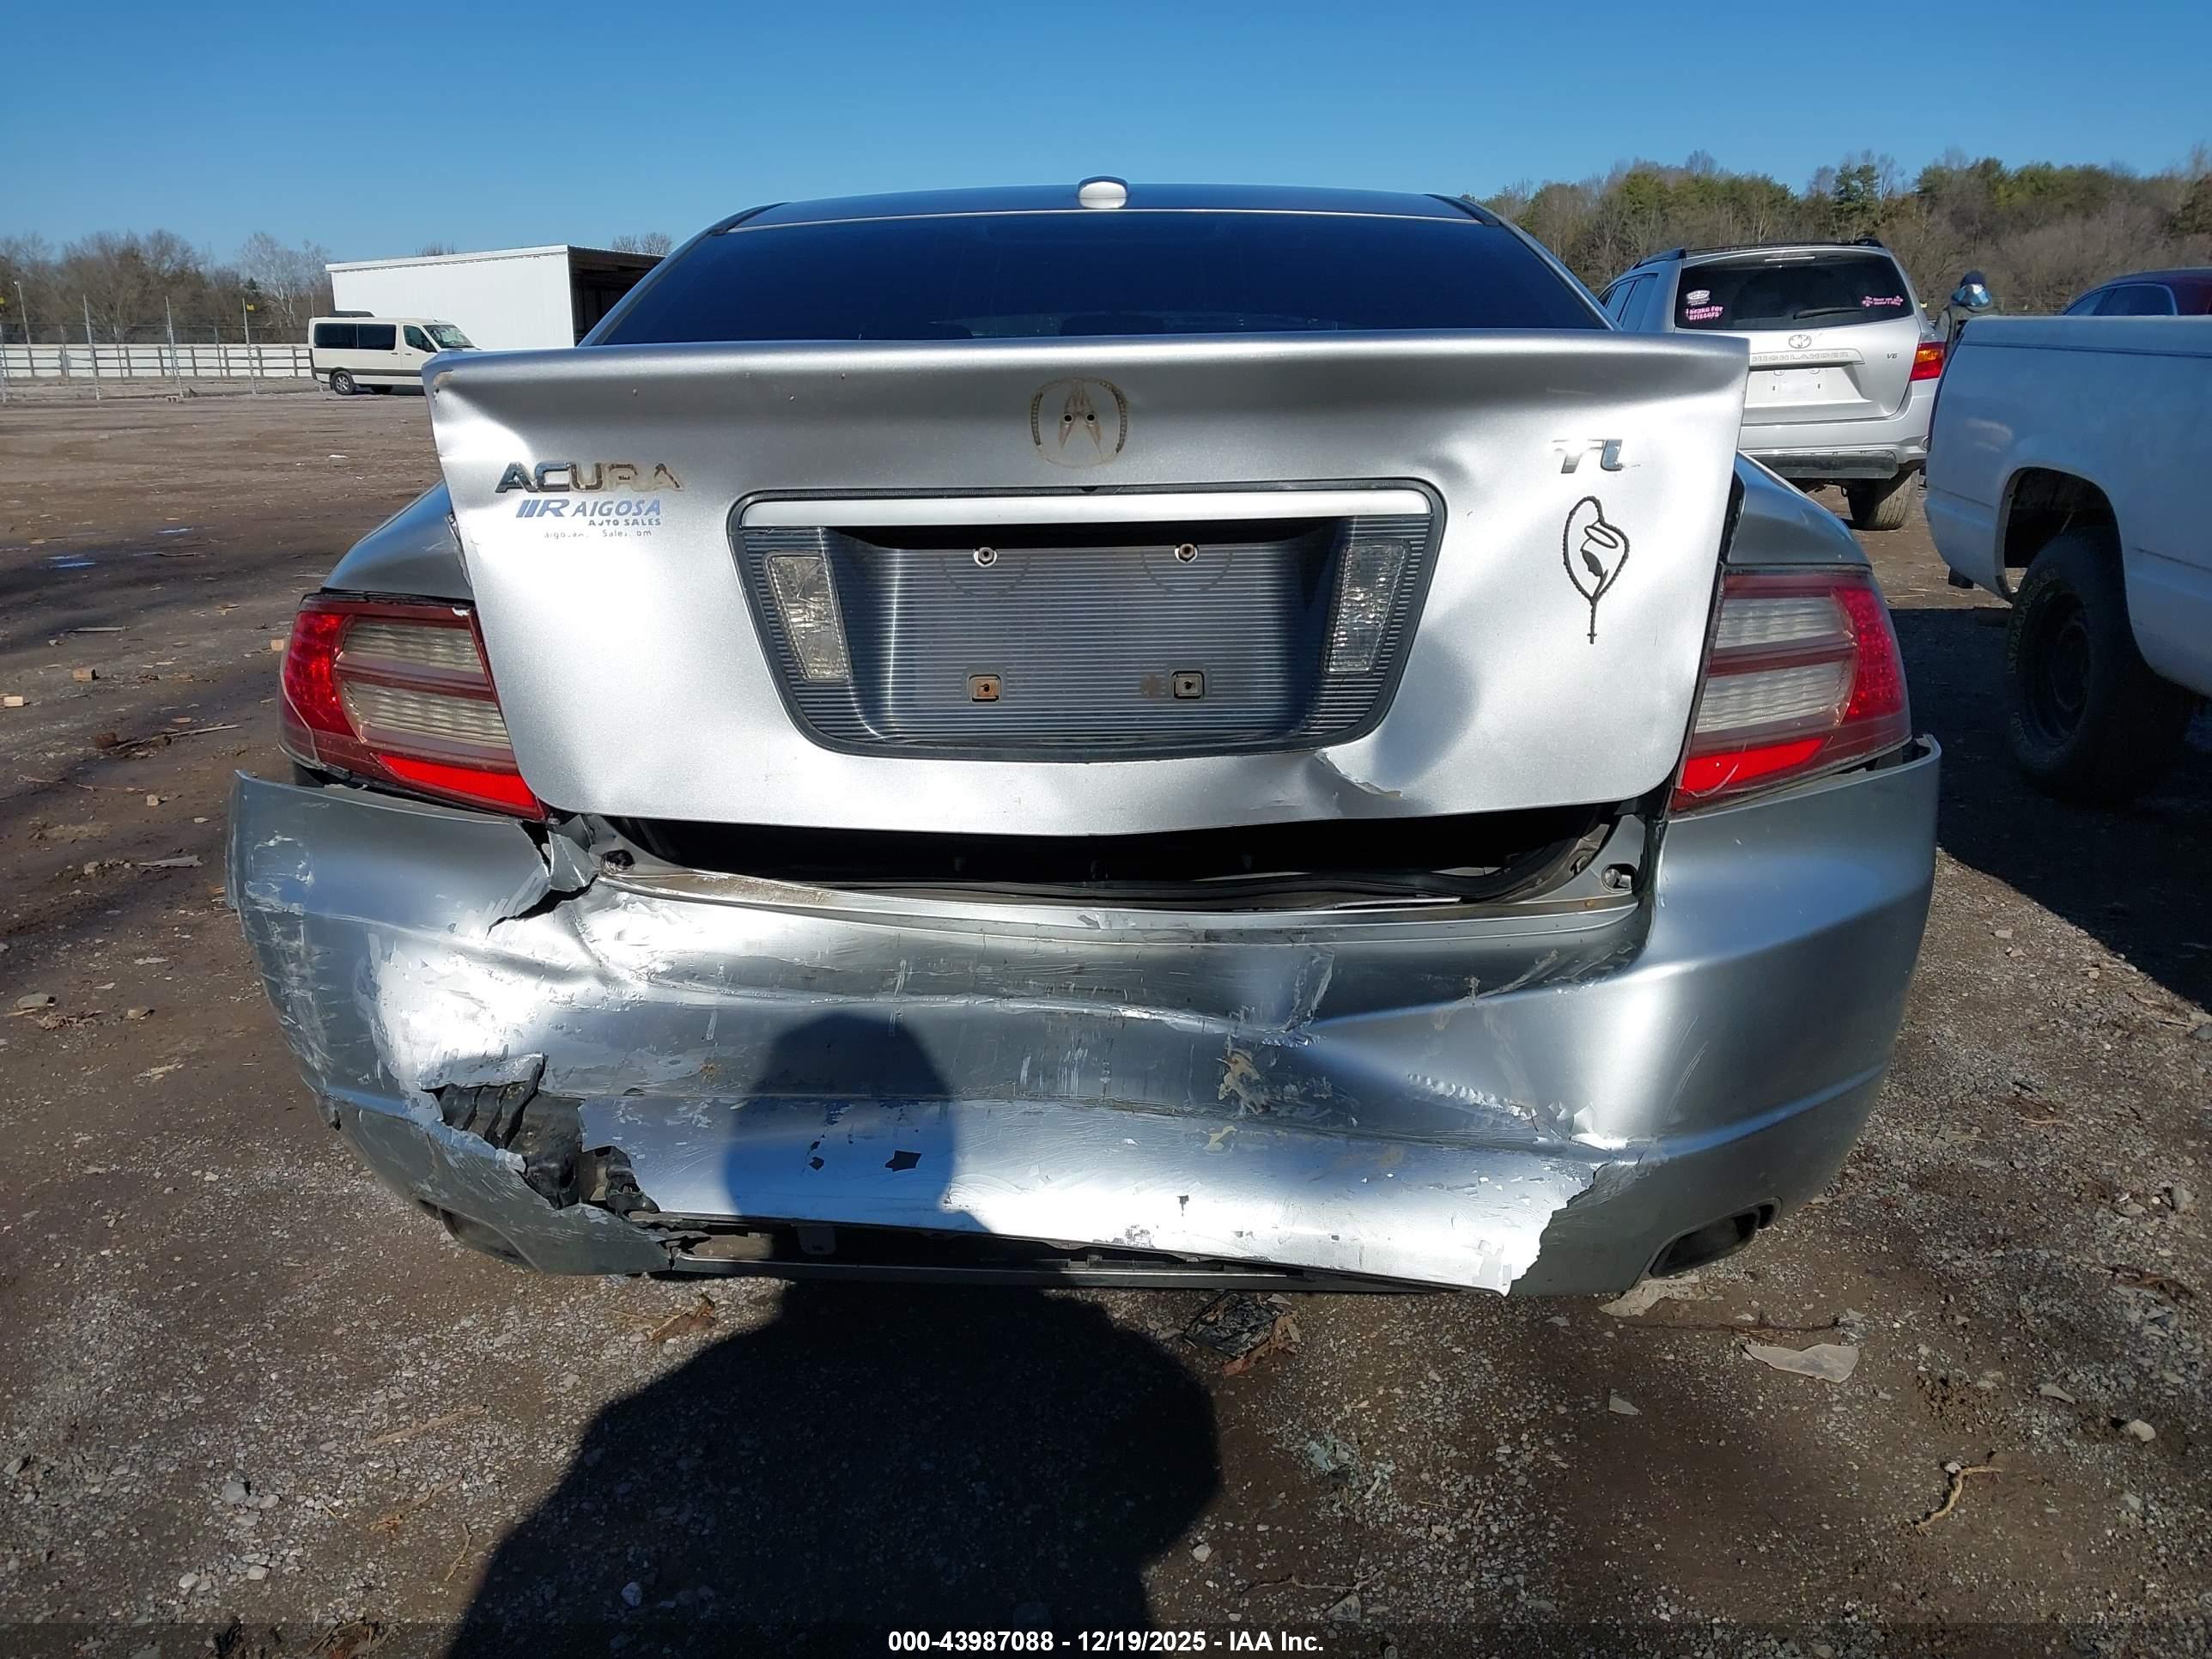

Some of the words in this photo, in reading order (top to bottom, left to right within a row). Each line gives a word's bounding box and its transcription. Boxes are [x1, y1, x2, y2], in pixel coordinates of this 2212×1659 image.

[1751, 351, 1850, 363] HIGHLANDER
[1552, 439, 1641, 474] TL
[495, 459, 684, 494] ACURA
[587, 518, 620, 526] AUTO
[624, 517, 661, 526] SALES
